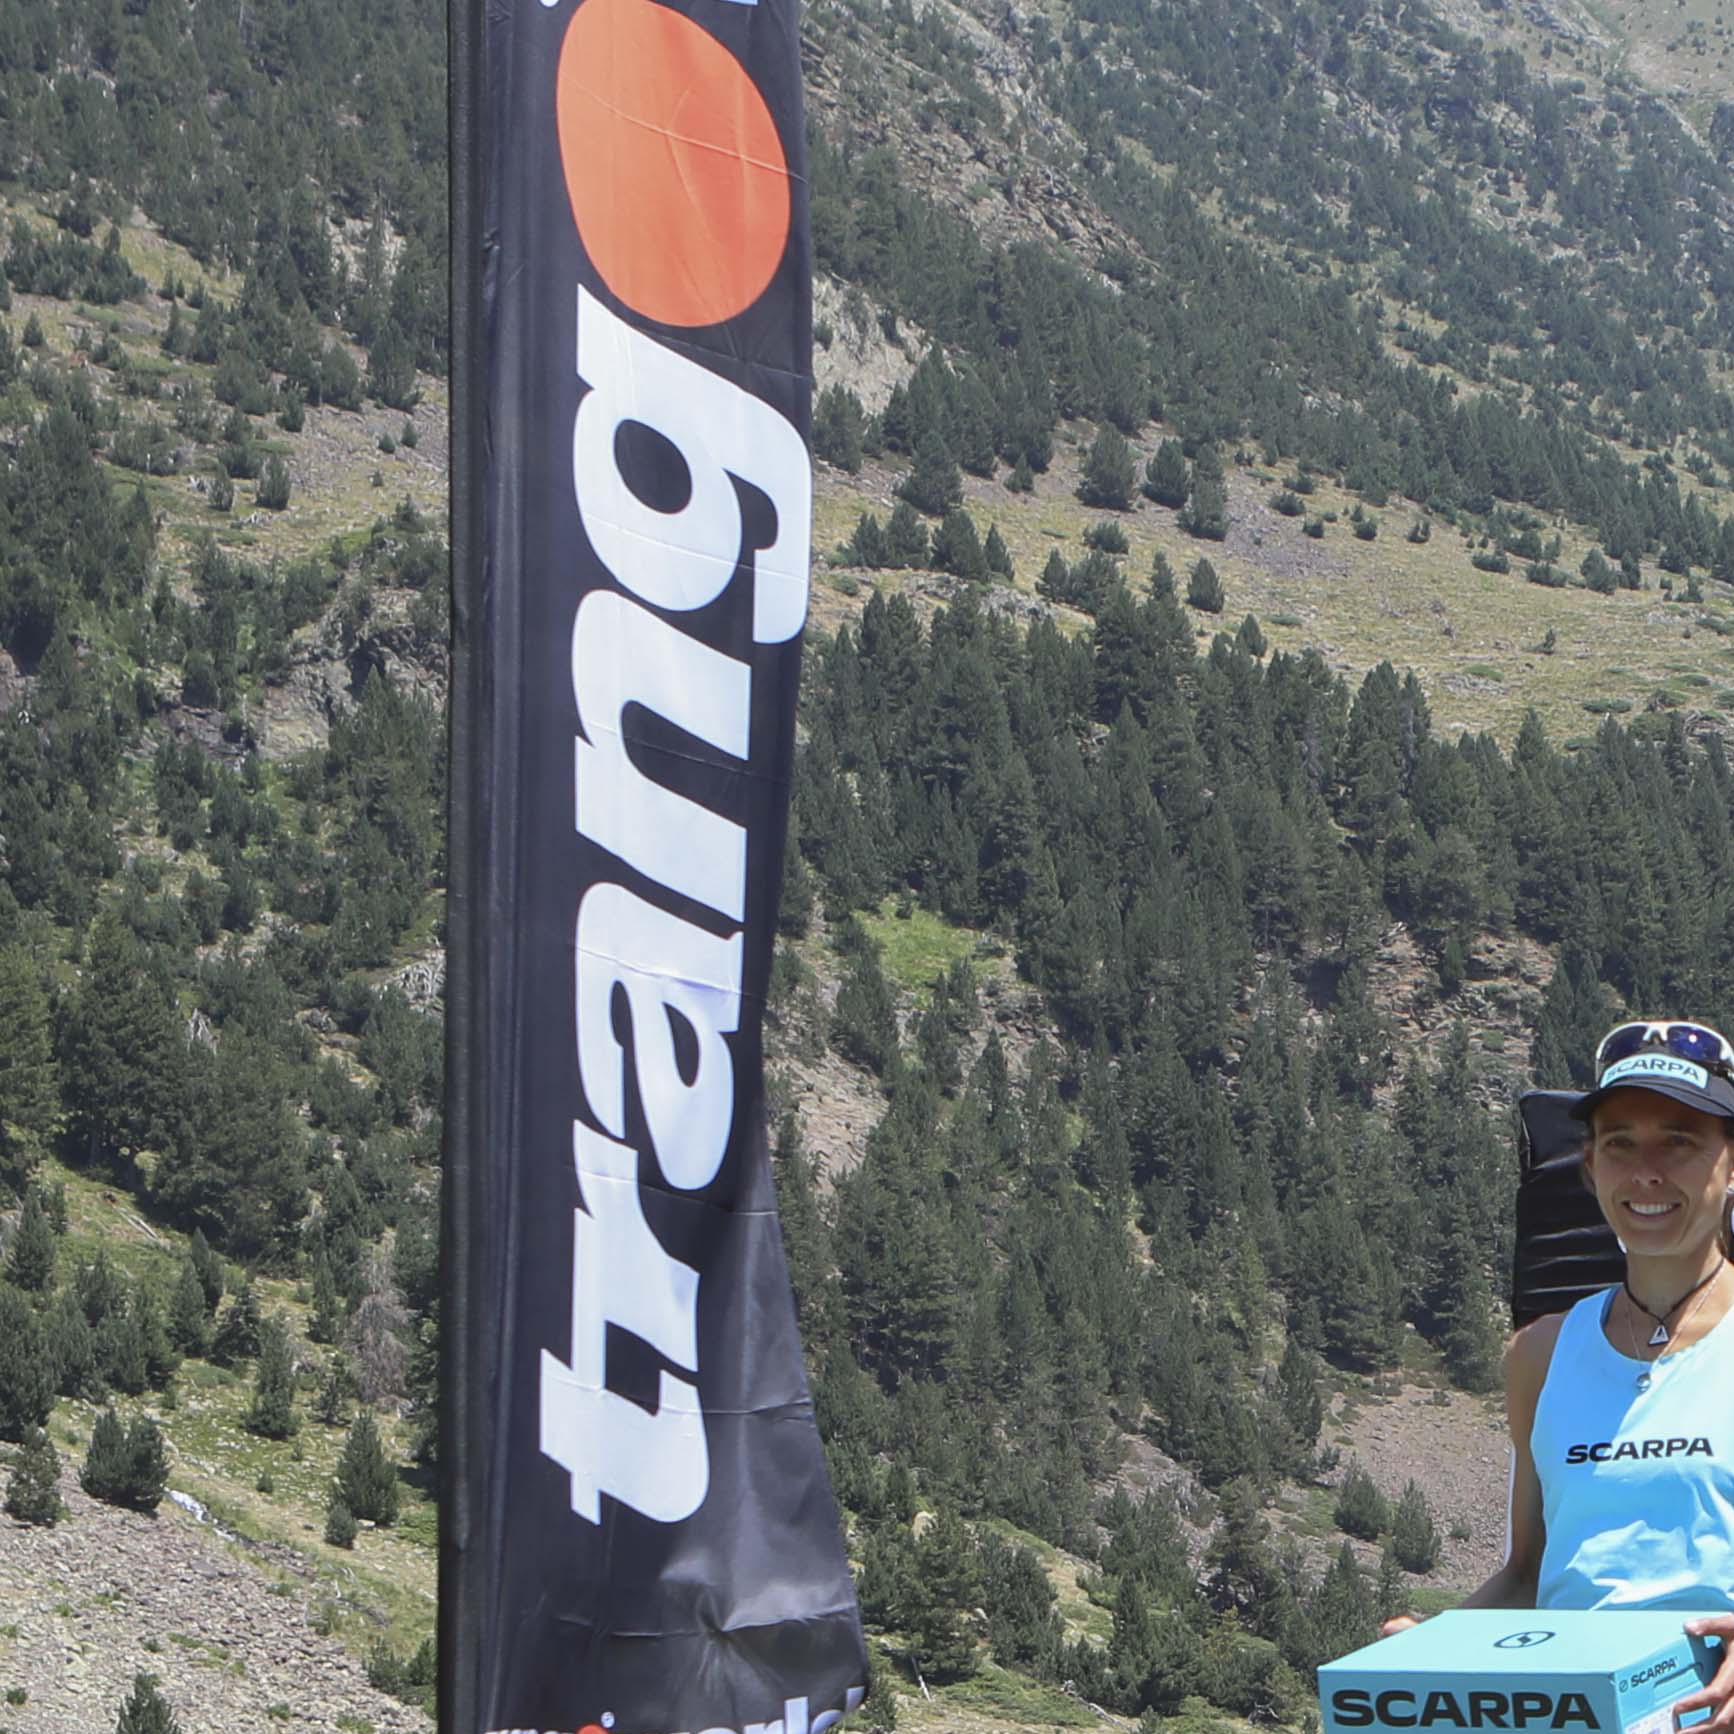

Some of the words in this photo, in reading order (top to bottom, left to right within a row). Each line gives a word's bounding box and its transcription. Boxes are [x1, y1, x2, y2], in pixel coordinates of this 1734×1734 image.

[1606, 1057, 1700, 1081] SCARPA
[1565, 1436, 1714, 1465] SCARPA
[1631, 1656, 1677, 1688] SCARPA
[1332, 1689, 1600, 1730] SCARPA
